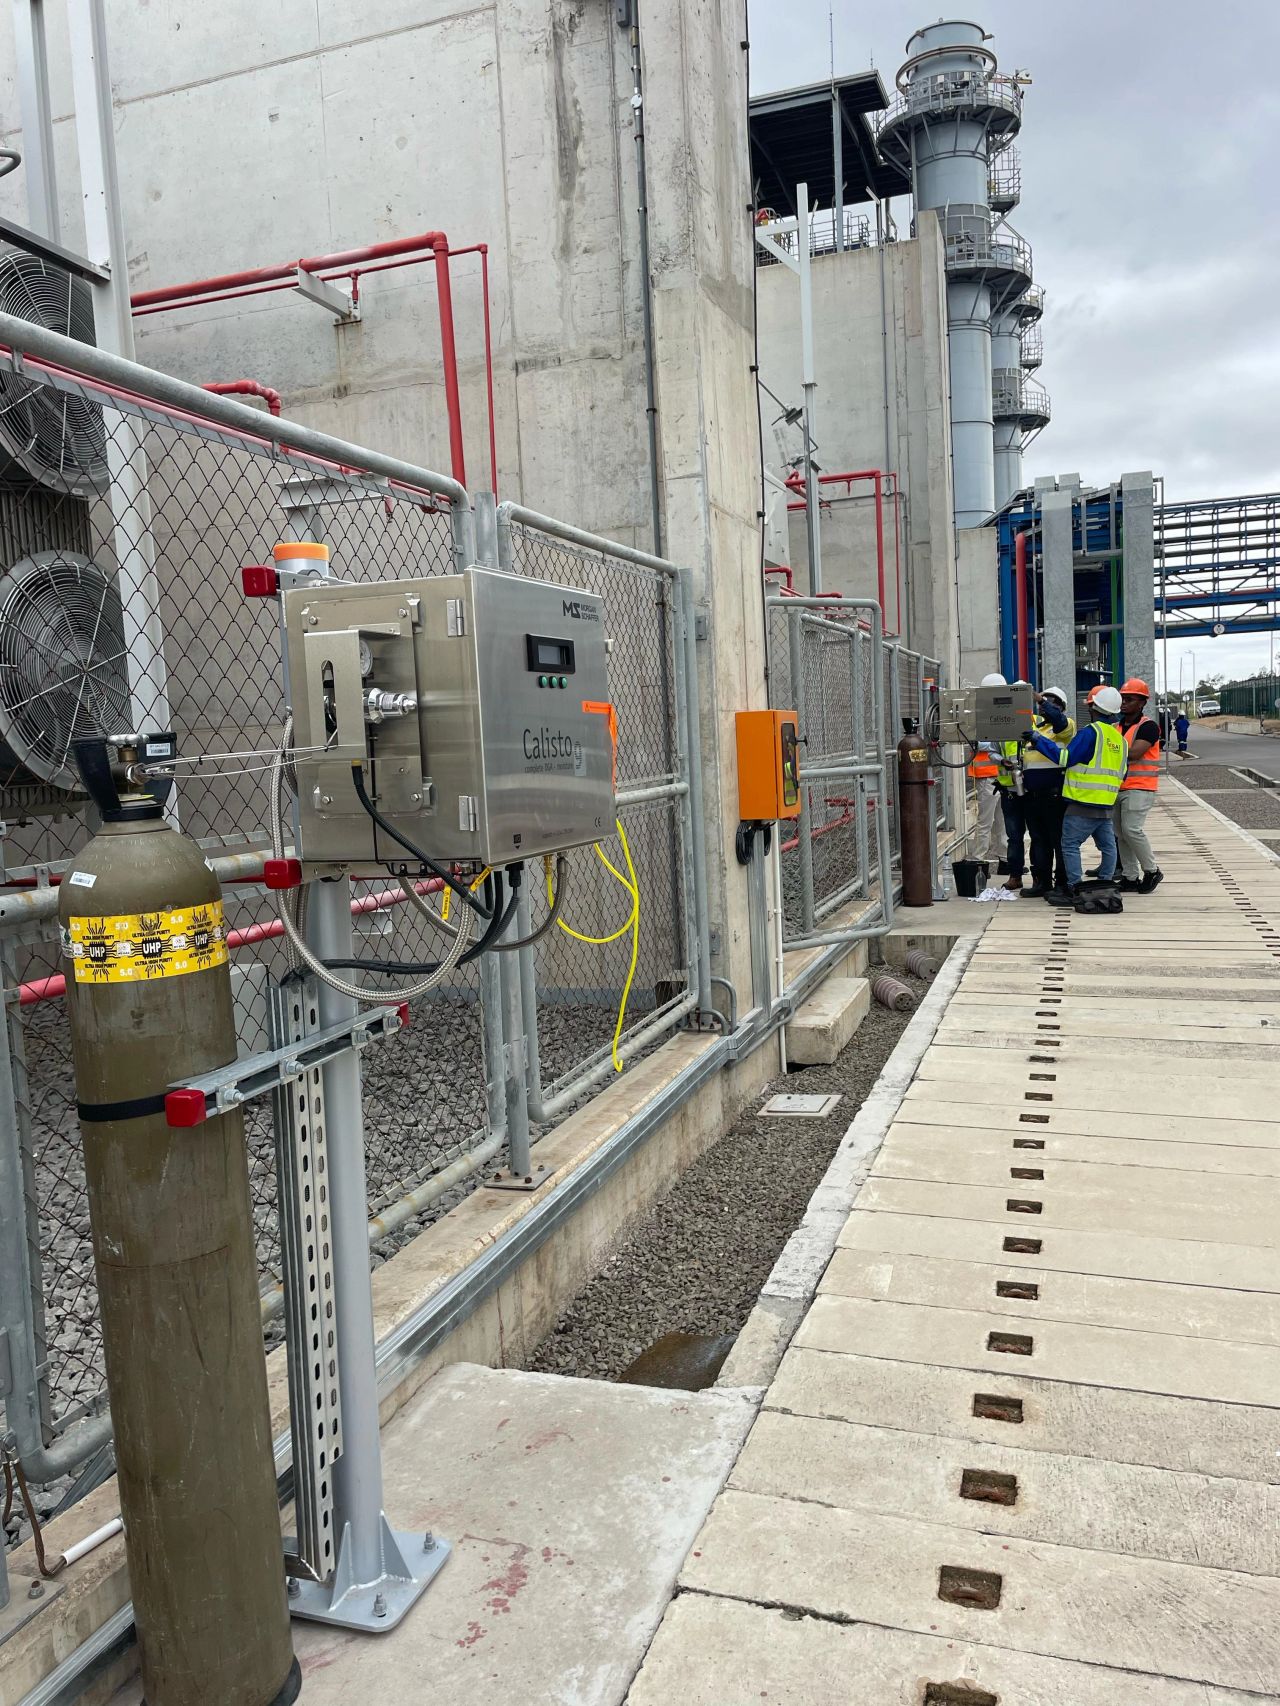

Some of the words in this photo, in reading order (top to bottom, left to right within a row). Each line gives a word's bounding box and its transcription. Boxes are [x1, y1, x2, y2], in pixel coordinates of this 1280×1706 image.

[523, 727, 573, 760] Calisto
[171, 915, 183, 924] 5.0
[195, 932, 208, 946] UHP
[89, 946, 105, 958] UHP
[142, 942, 161, 954] UHP
[175, 960, 187, 969] 5.0
[120, 968, 133, 976] 5.0
